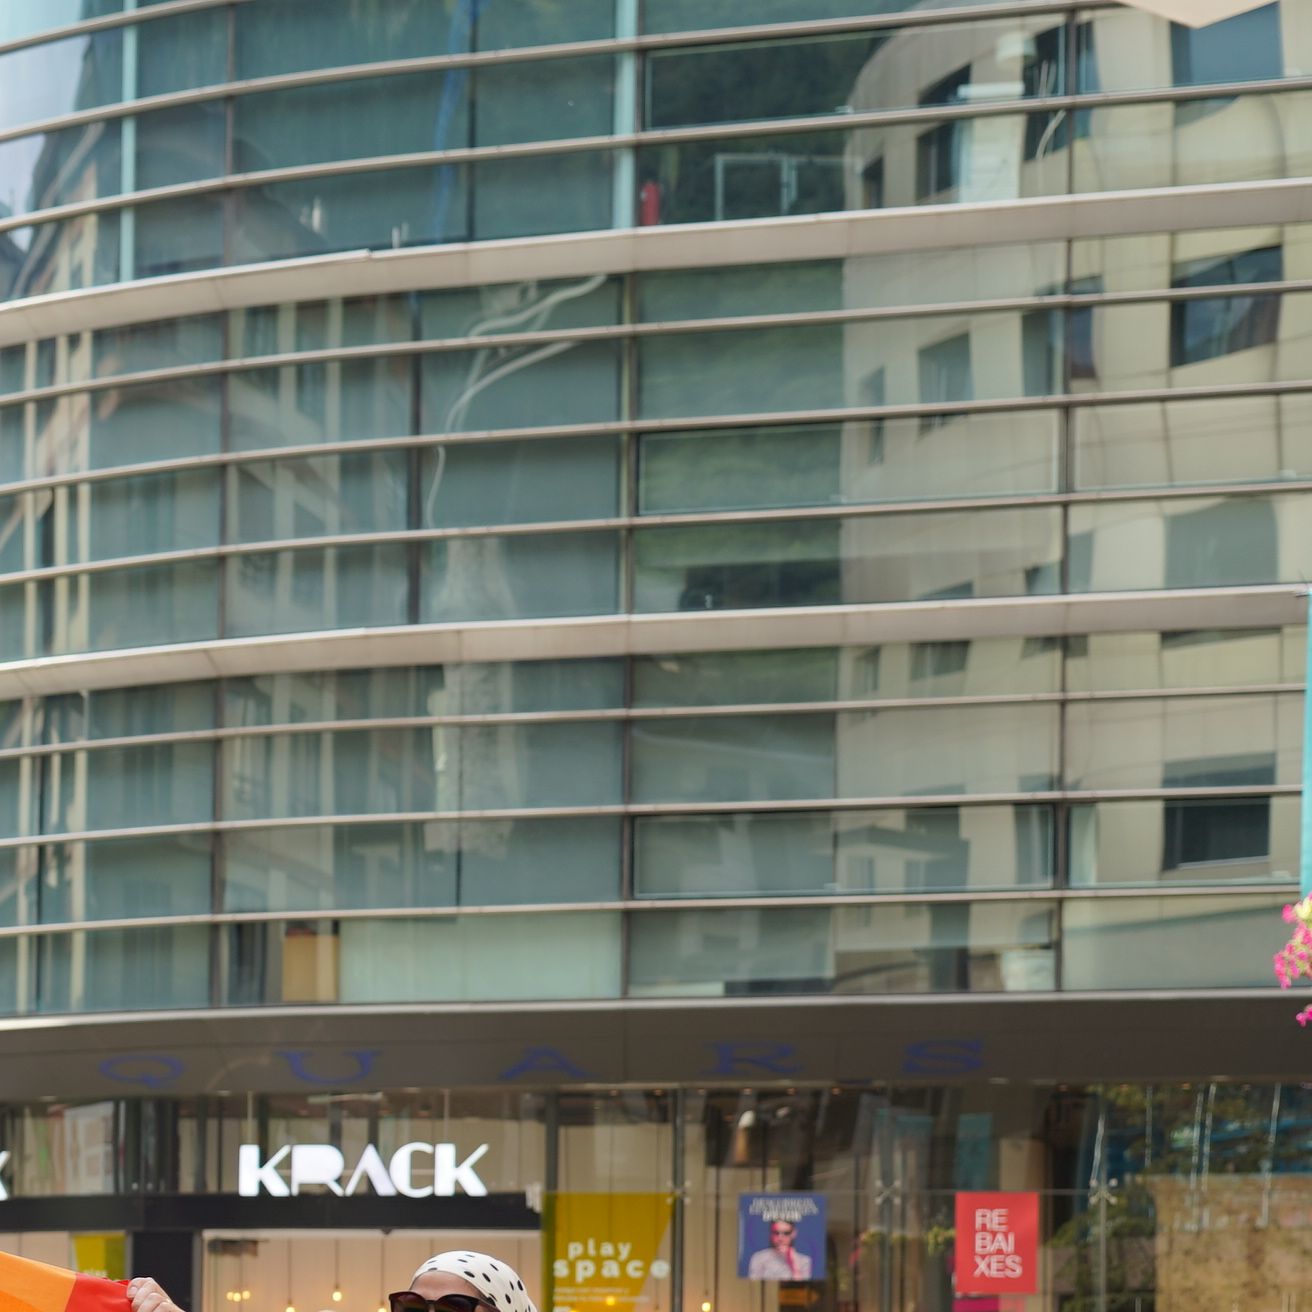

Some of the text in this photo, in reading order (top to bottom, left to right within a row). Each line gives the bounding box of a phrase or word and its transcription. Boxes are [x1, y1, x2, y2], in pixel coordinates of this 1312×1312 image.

[237, 1141, 490, 1199] KRACK
[975, 1207, 1009, 1231] RE
[567, 1237, 633, 1261] play
[975, 1231, 1016, 1255] BAI
[552, 1258, 671, 1283] space
[973, 1253, 1023, 1279] XES
